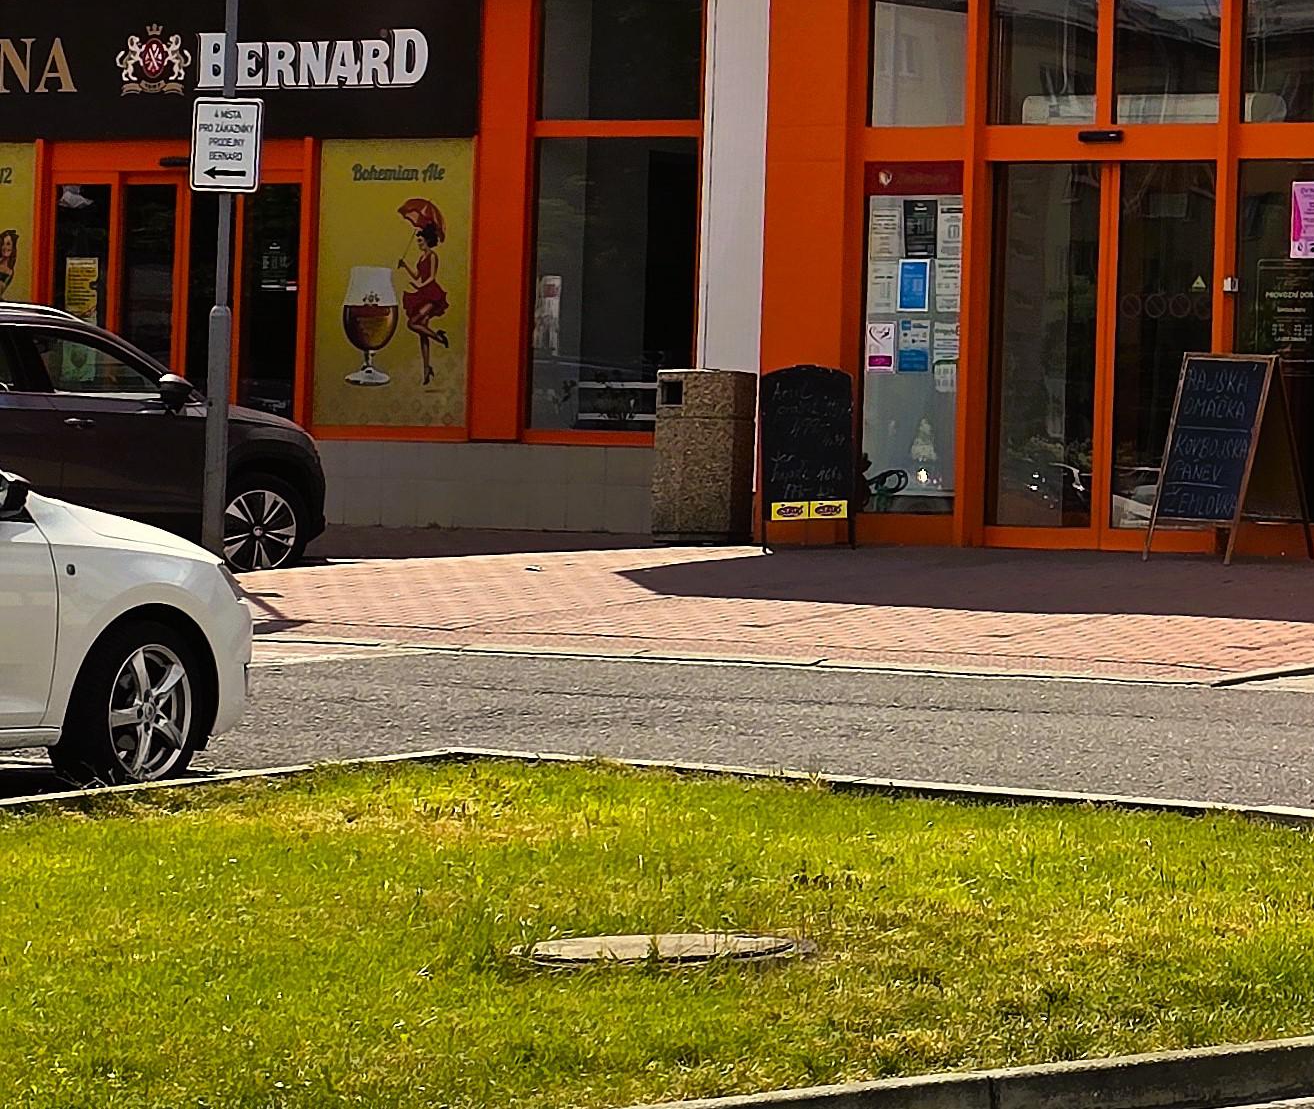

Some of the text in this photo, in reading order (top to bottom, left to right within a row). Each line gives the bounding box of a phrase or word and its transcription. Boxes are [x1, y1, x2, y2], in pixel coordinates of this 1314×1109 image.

[197, 29, 428, 89] BERNARD
[198, 123, 213, 133] PRO
[351, 162, 446, 183] Bohemian Ale
